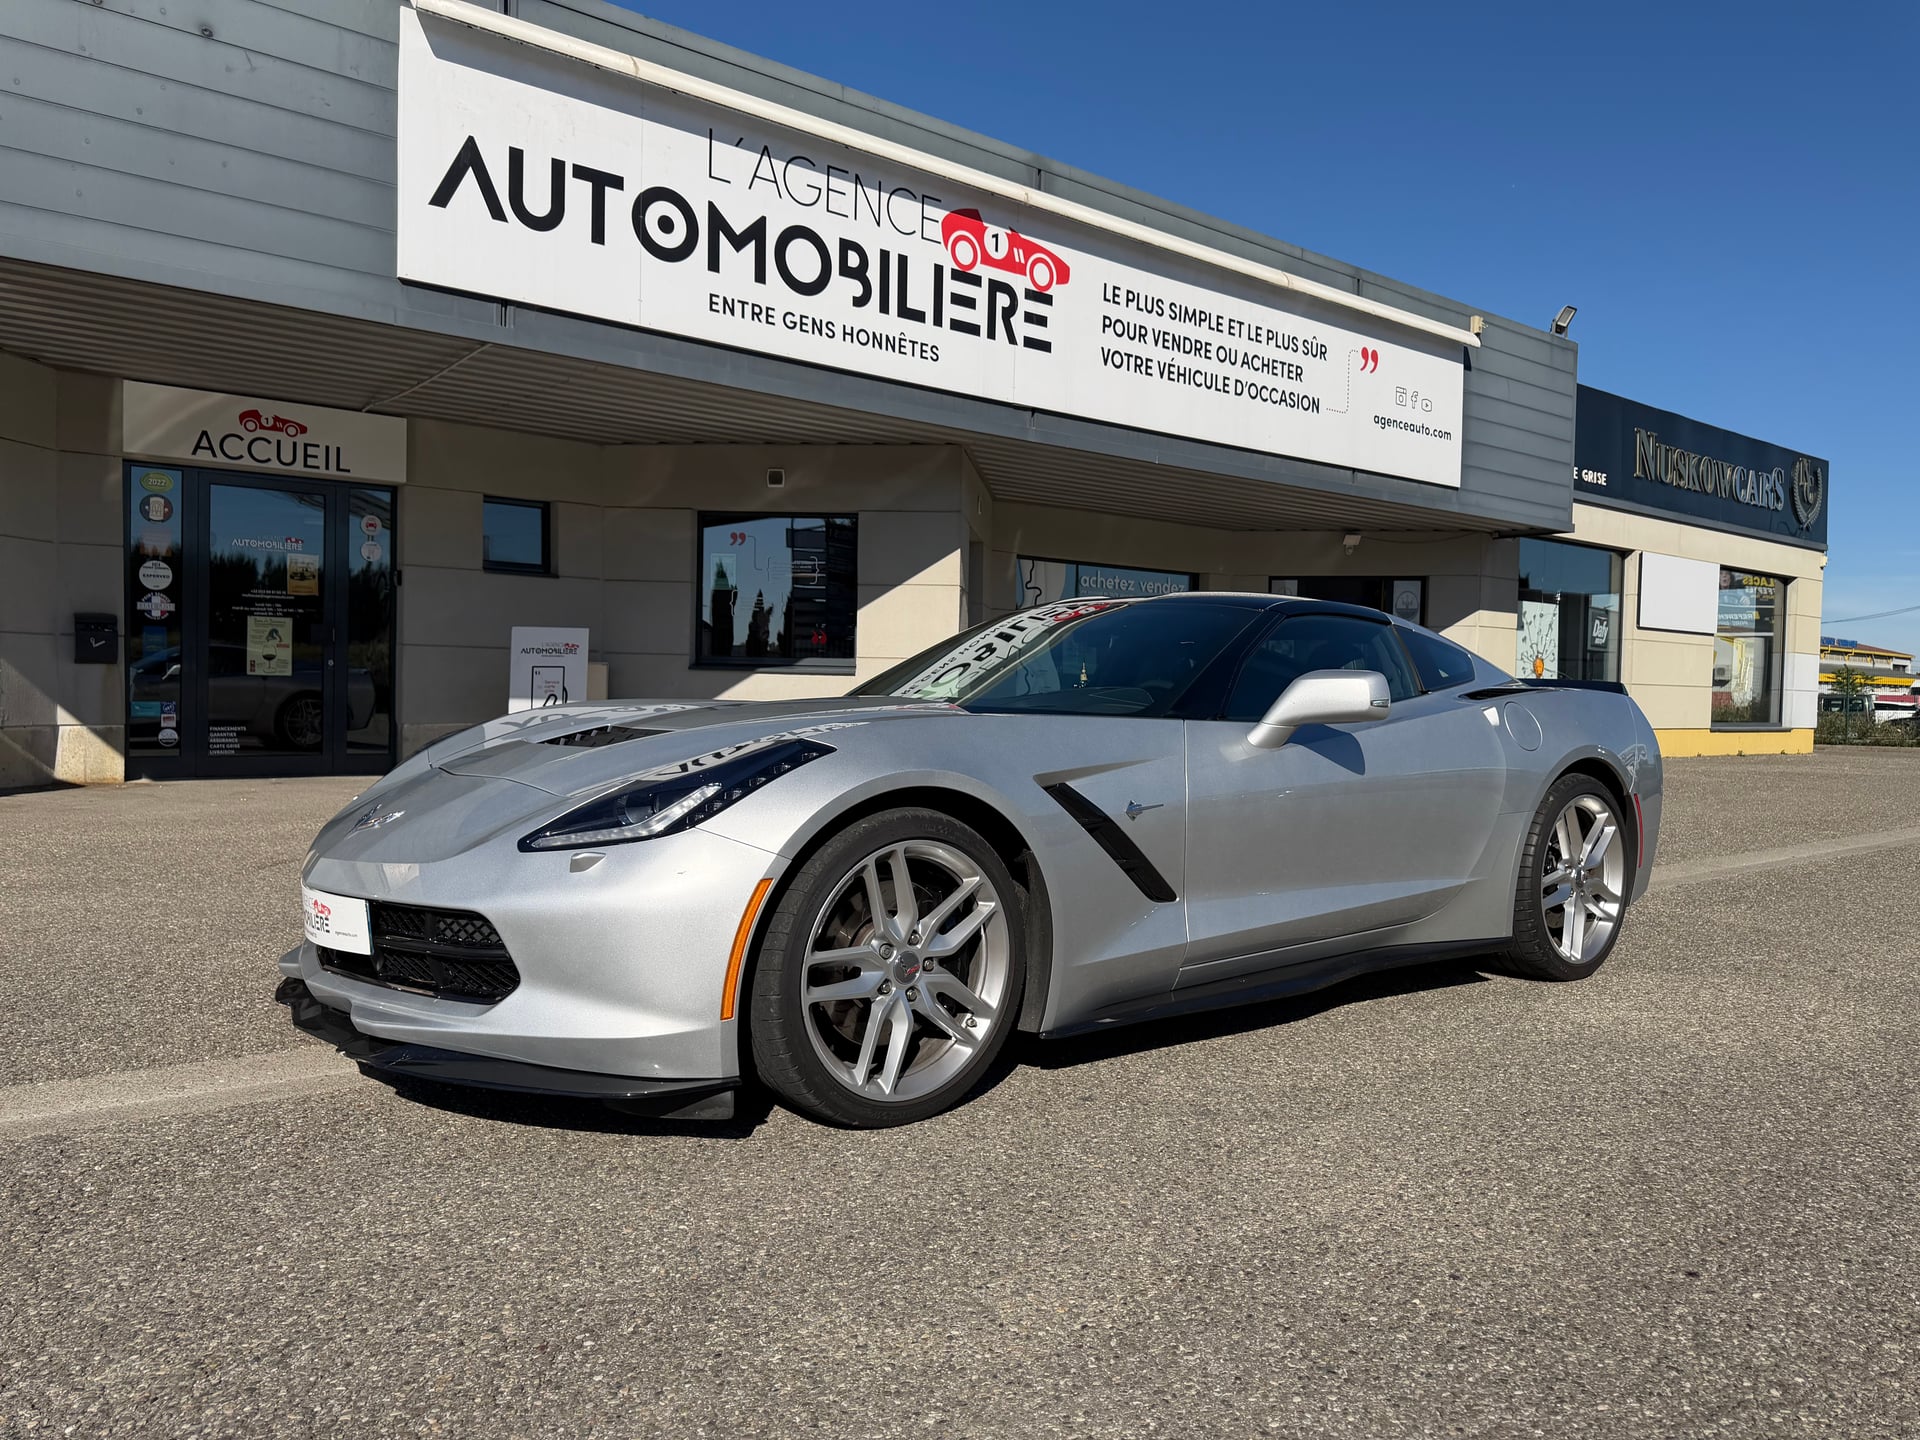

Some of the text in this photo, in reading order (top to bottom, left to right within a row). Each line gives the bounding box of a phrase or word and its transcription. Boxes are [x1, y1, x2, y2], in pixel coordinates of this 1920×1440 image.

[708, 292, 940, 363] ENTRE GENS HONNÊTES
[1104, 282, 1328, 361] LE PLUS SIMPLE ET LE PLUS SÛR
[1102, 315, 1304, 383] POUR VENDRE OU ACHETER
[1101, 346, 1320, 414] VOTRE VÉHICULE D'OCCASION
[1373, 414, 1452, 441] agenceauto.com
[191, 430, 351, 473] ACCUEIL
[148, 477, 167, 487] 2022
[1582, 468, 1608, 486] GRISE
[1080, 570, 1186, 594] achetez vendez
[1592, 619, 1608, 644] Dafy
